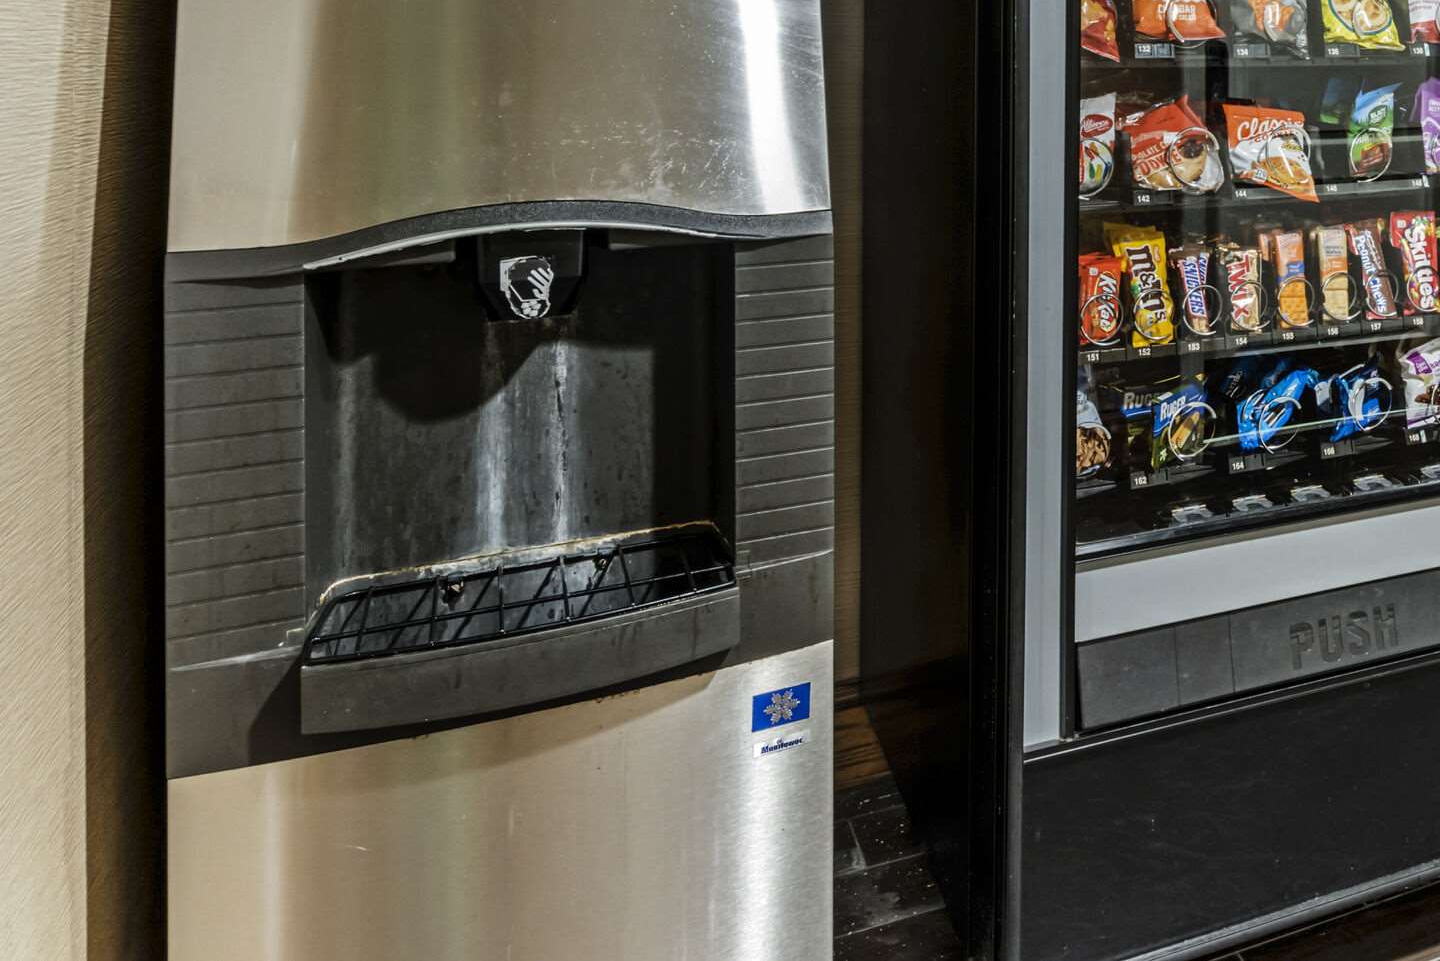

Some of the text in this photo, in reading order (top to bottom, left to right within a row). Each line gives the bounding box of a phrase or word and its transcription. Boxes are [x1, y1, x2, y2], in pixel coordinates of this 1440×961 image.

[1227, 254, 1250, 320] TWIX
[1138, 348, 1151, 356] 152
[1160, 396, 1186, 421] RUGER
[1290, 603, 1399, 671] PUSH
